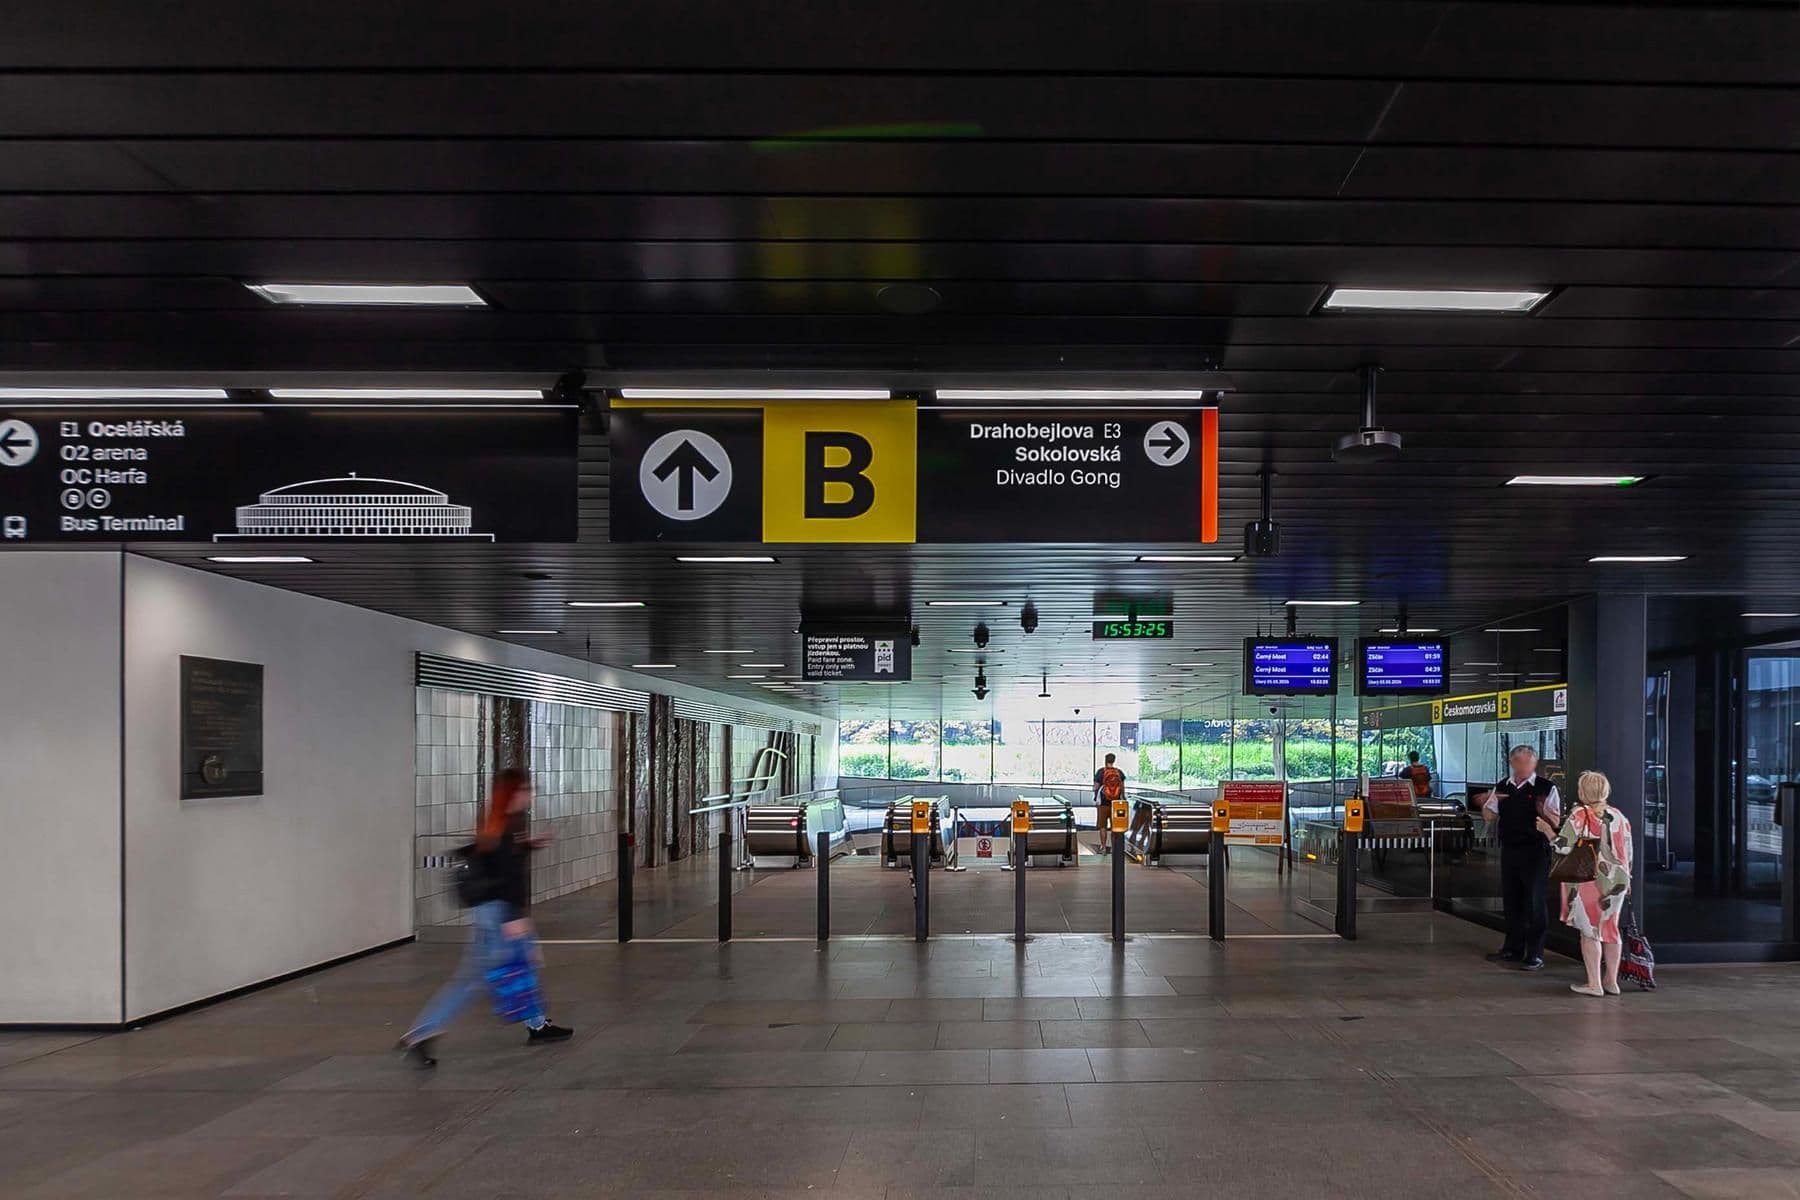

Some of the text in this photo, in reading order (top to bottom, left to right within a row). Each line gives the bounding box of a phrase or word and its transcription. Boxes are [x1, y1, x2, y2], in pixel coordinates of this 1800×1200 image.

[60, 420, 185, 437] E1 Ocelářská
[970, 423, 1121, 442] Drahobejlova E3
[92, 448, 148, 461] arena
[1015, 446, 1121, 462] Sokolovská
[60, 468, 147, 484] OC Harfa
[804, 431, 875, 519] B
[996, 469, 1121, 489] Divadlo Gong
[60, 515, 184, 531] Bus Terminal
[1104, 623, 1166, 636] 15:53:25
[1255, 652, 1271, 661] Černý
[1255, 665, 1271, 674] Černý
[1433, 697, 1509, 720] B Českomoravská B
